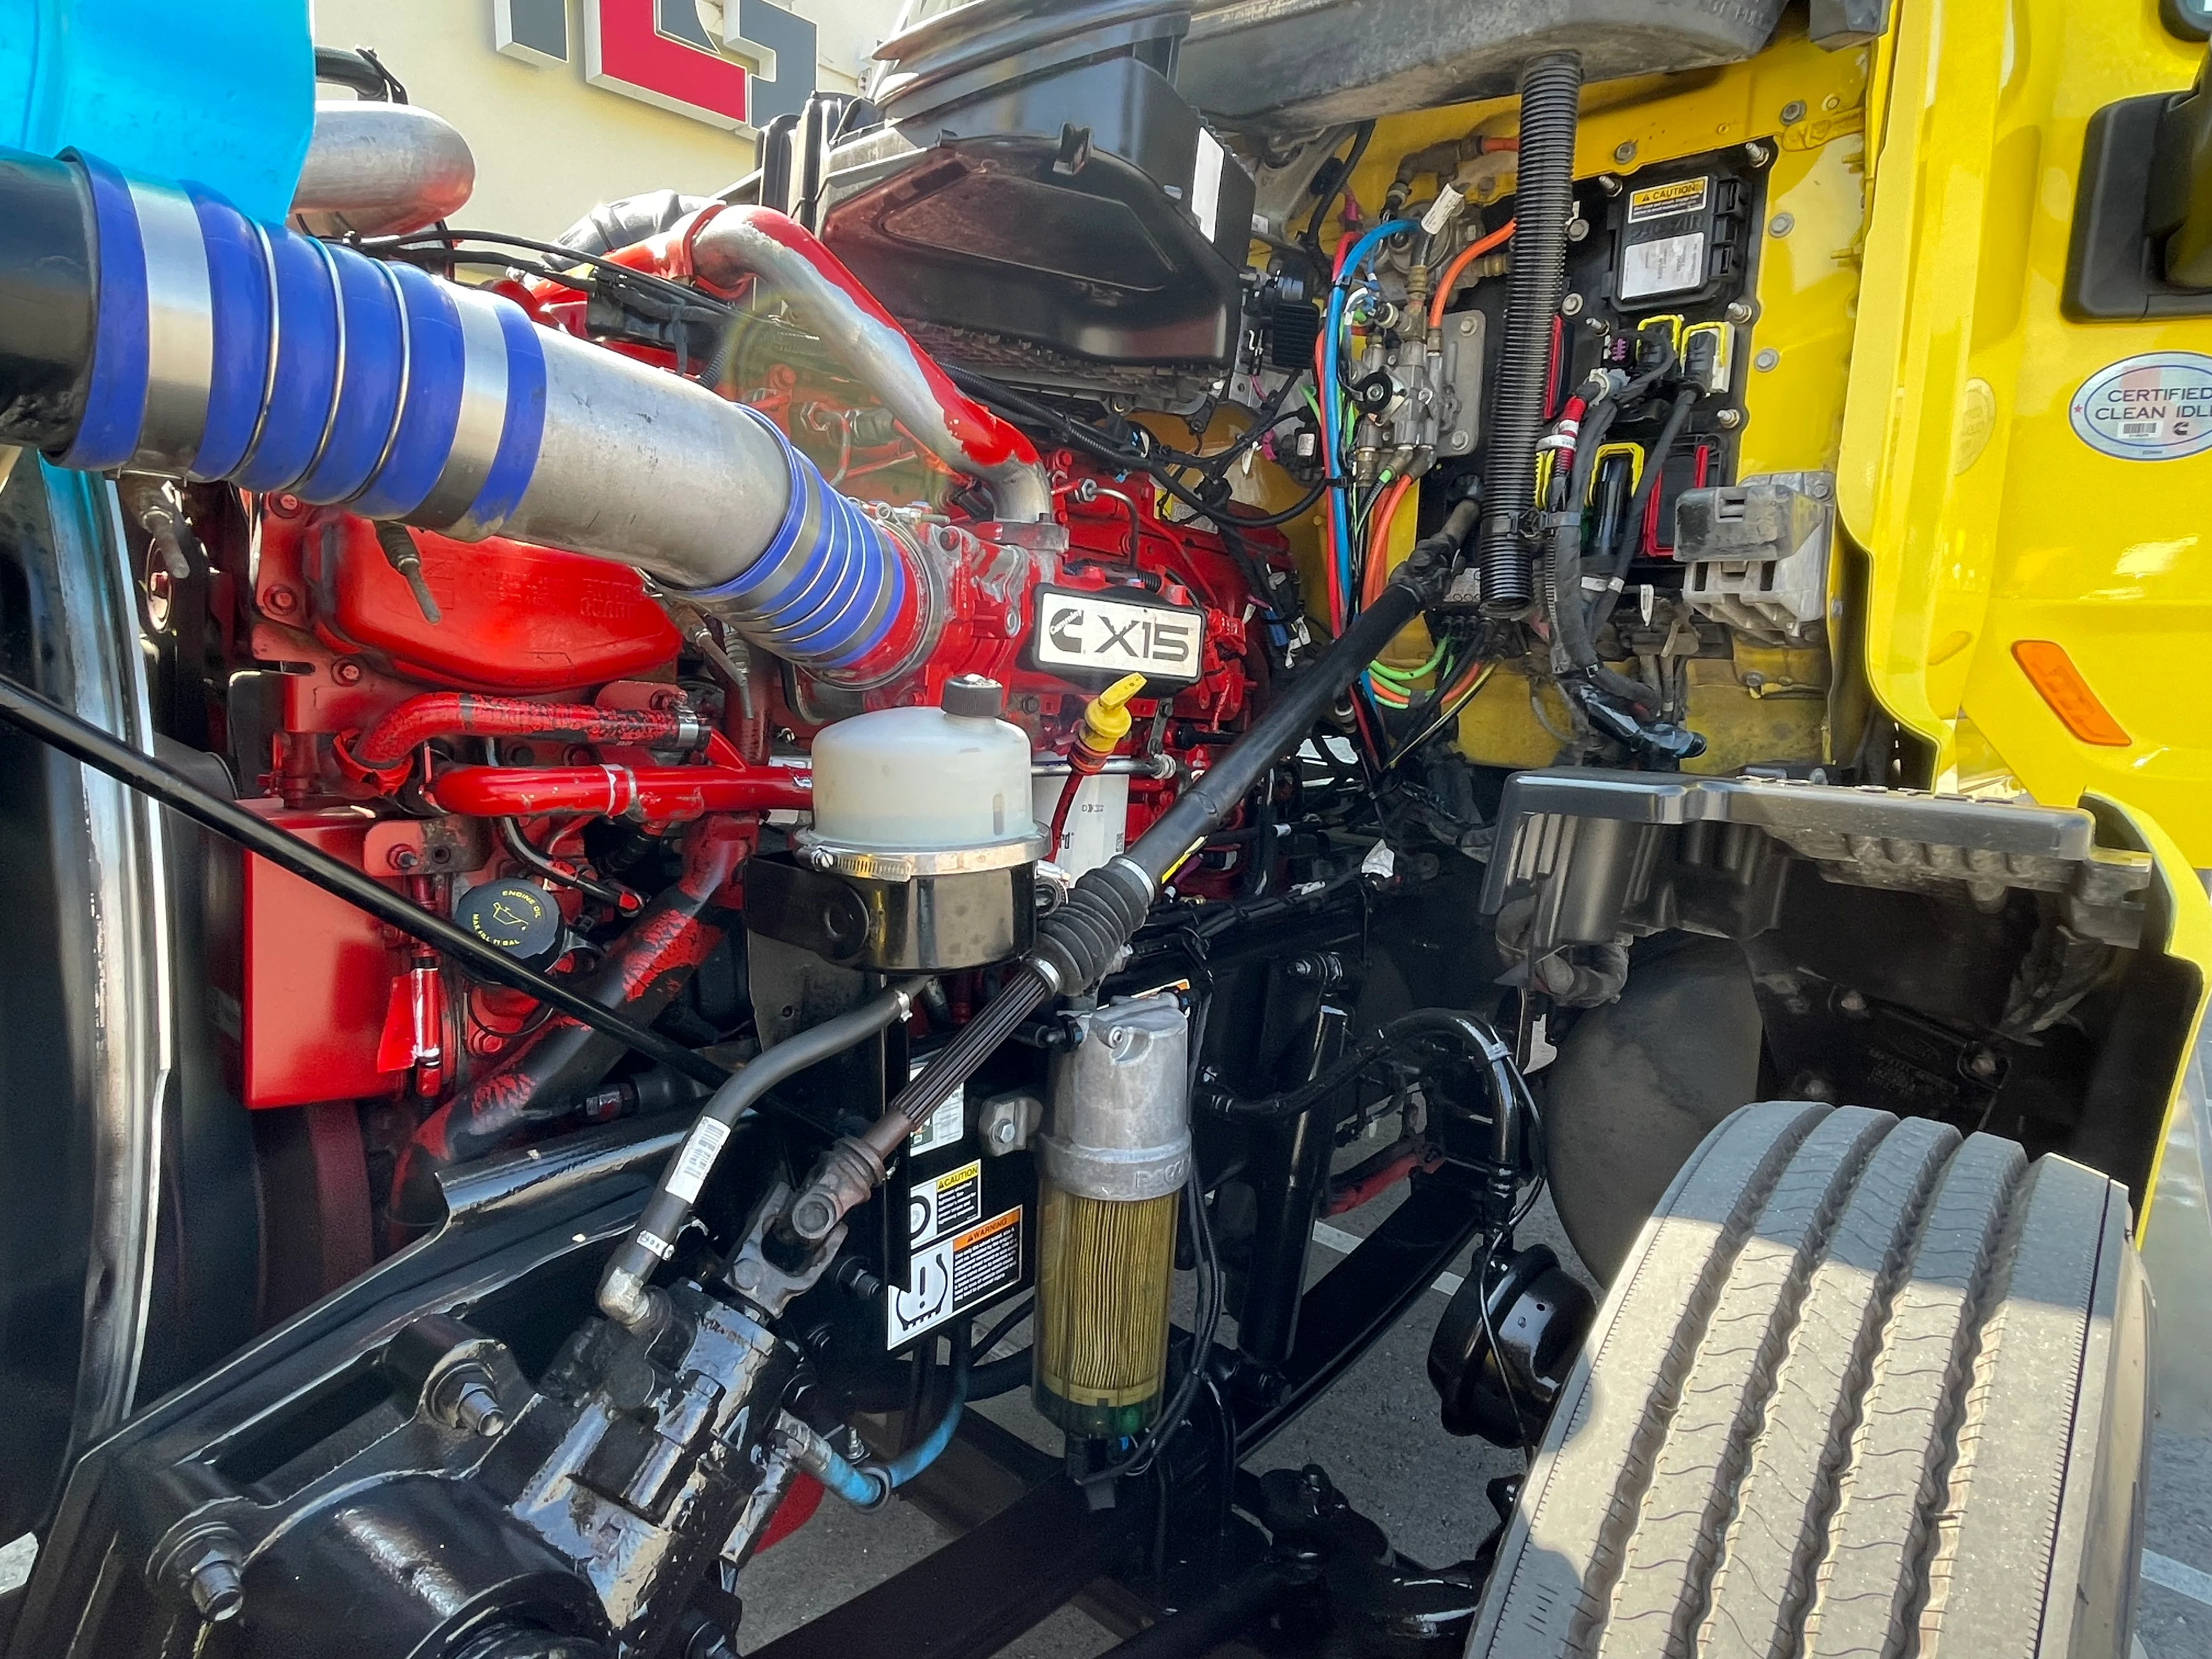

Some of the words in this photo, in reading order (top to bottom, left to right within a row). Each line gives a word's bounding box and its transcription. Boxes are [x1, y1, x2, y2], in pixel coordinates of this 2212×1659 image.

[1652, 184, 1695, 200] CAUTION
[2107, 388, 2212, 402] CERTIFIED
[2095, 406, 2166, 420] CLEAN
[2176, 405, 2212, 418] IDL
[1094, 614, 1189, 662] X15
[502, 890, 536, 905] ENGINE
[944, 1166, 977, 1186] CAUTION
[973, 1217, 1007, 1239] WARNING
